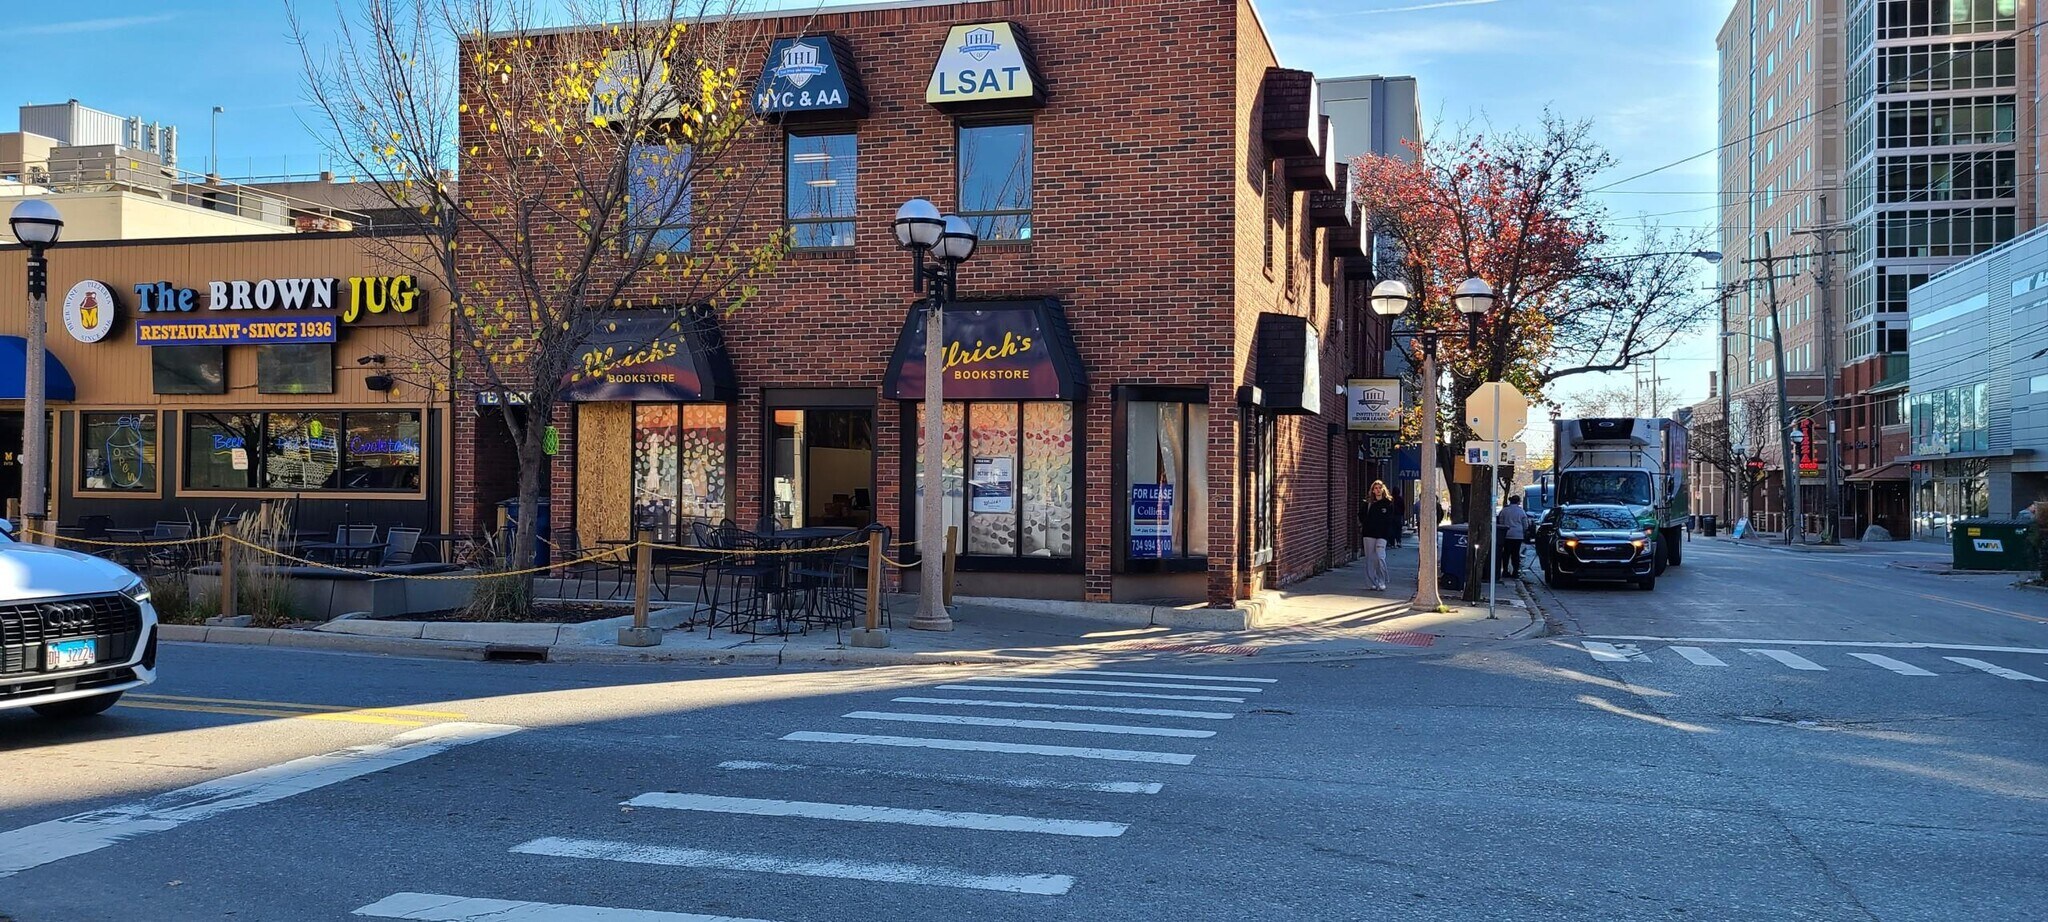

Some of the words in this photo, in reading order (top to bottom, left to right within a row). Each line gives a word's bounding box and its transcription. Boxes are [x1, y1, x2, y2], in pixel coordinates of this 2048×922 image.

[969, 33, 991, 45] IHL
[788, 51, 814, 65] IHL
[939, 66, 1021, 95] LSAT
[758, 91, 795, 109] NYC
[799, 90, 812, 107] &
[815, 88, 842, 106] AA
[134, 281, 193, 312] The
[208, 277, 335, 311] BROWN
[343, 274, 414, 323] JUG
[140, 324, 241, 341] RESTAURANT
[249, 322, 297, 339] SINCE
[300, 321, 332, 338] 1936
[941, 331, 1032, 373] lrich's
[607, 374, 676, 384] BOOKSTORE
[954, 369, 1030, 380] BOOKSTORE
[1399, 470, 1420, 478] ATM
[1133, 488, 1148, 499] FOR
[1149, 488, 1173, 499] LEASE
[1131, 540, 1143, 551] 734
[1144, 540, 1156, 551] 994
